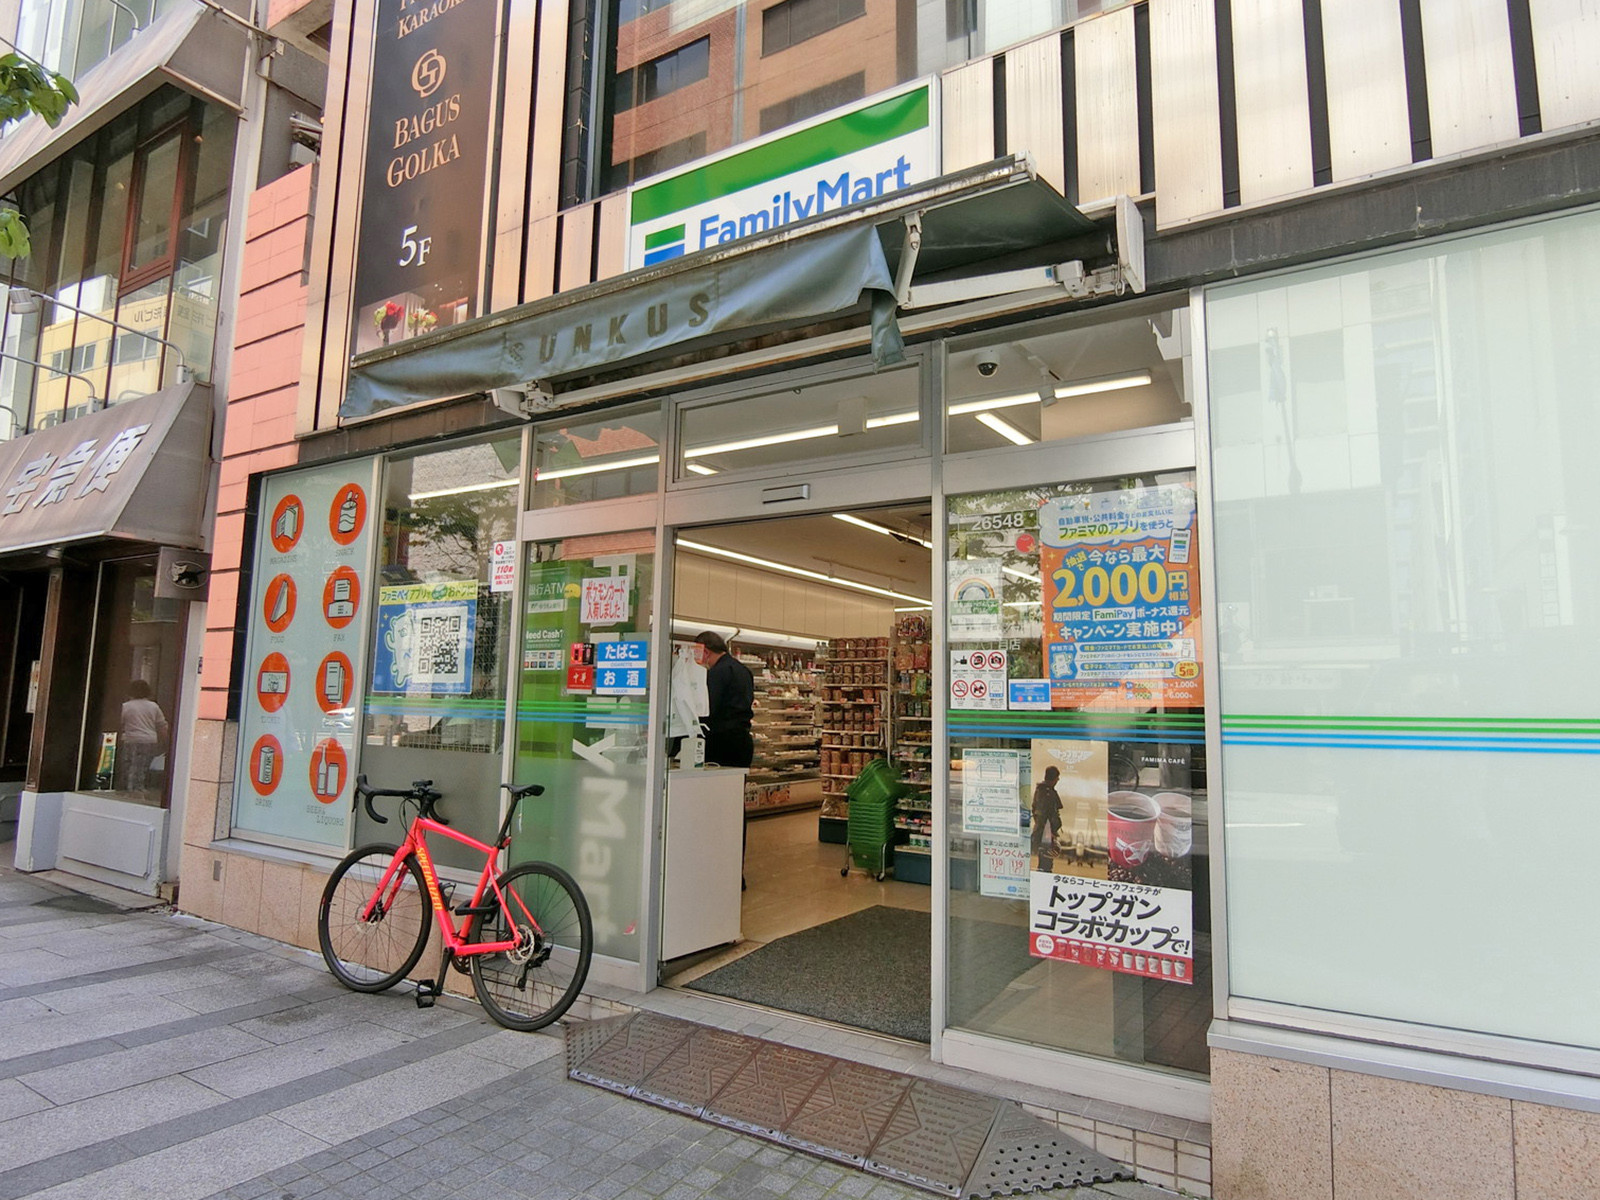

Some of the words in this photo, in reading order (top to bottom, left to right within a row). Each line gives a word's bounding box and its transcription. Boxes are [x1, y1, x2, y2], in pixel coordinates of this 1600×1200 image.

[397, 0, 464, 39] KARAO
[393, 93, 460, 149] BAGUS
[386, 133, 461, 188] GOLKA
[700, 155, 911, 250] FamilyMart
[399, 225, 432, 267] 5F
[508, 292, 711, 367] SUNKUS
[1, 423, 153, 516] 宅急便
[972, 512, 1024, 531] 26548
[1059, 519, 1174, 539] ファミマのアプリを使うと
[1088, 544, 1166, 565] 今なら最大
[1052, 562, 1167, 608] 2,000
[1053, 610, 1092, 622] 期間限定
[1094, 609, 1134, 620] FamiPay
[333, 634, 345, 642] FAX
[604, 643, 640, 660] たばこ
[603, 670, 640, 686] お酒
[1179, 668, 1195, 677] 5倍
[264, 753, 272, 782] DRINK
[1141, 756, 1167, 764] FAMIMA
[415, 846, 443, 911] SPECIALIZED
[1053, 875, 1162, 896] 今ならコーヒー・カフェラテが
[1049, 885, 1162, 920] トップガン
[1034, 909, 1191, 955] コラボカップで!
